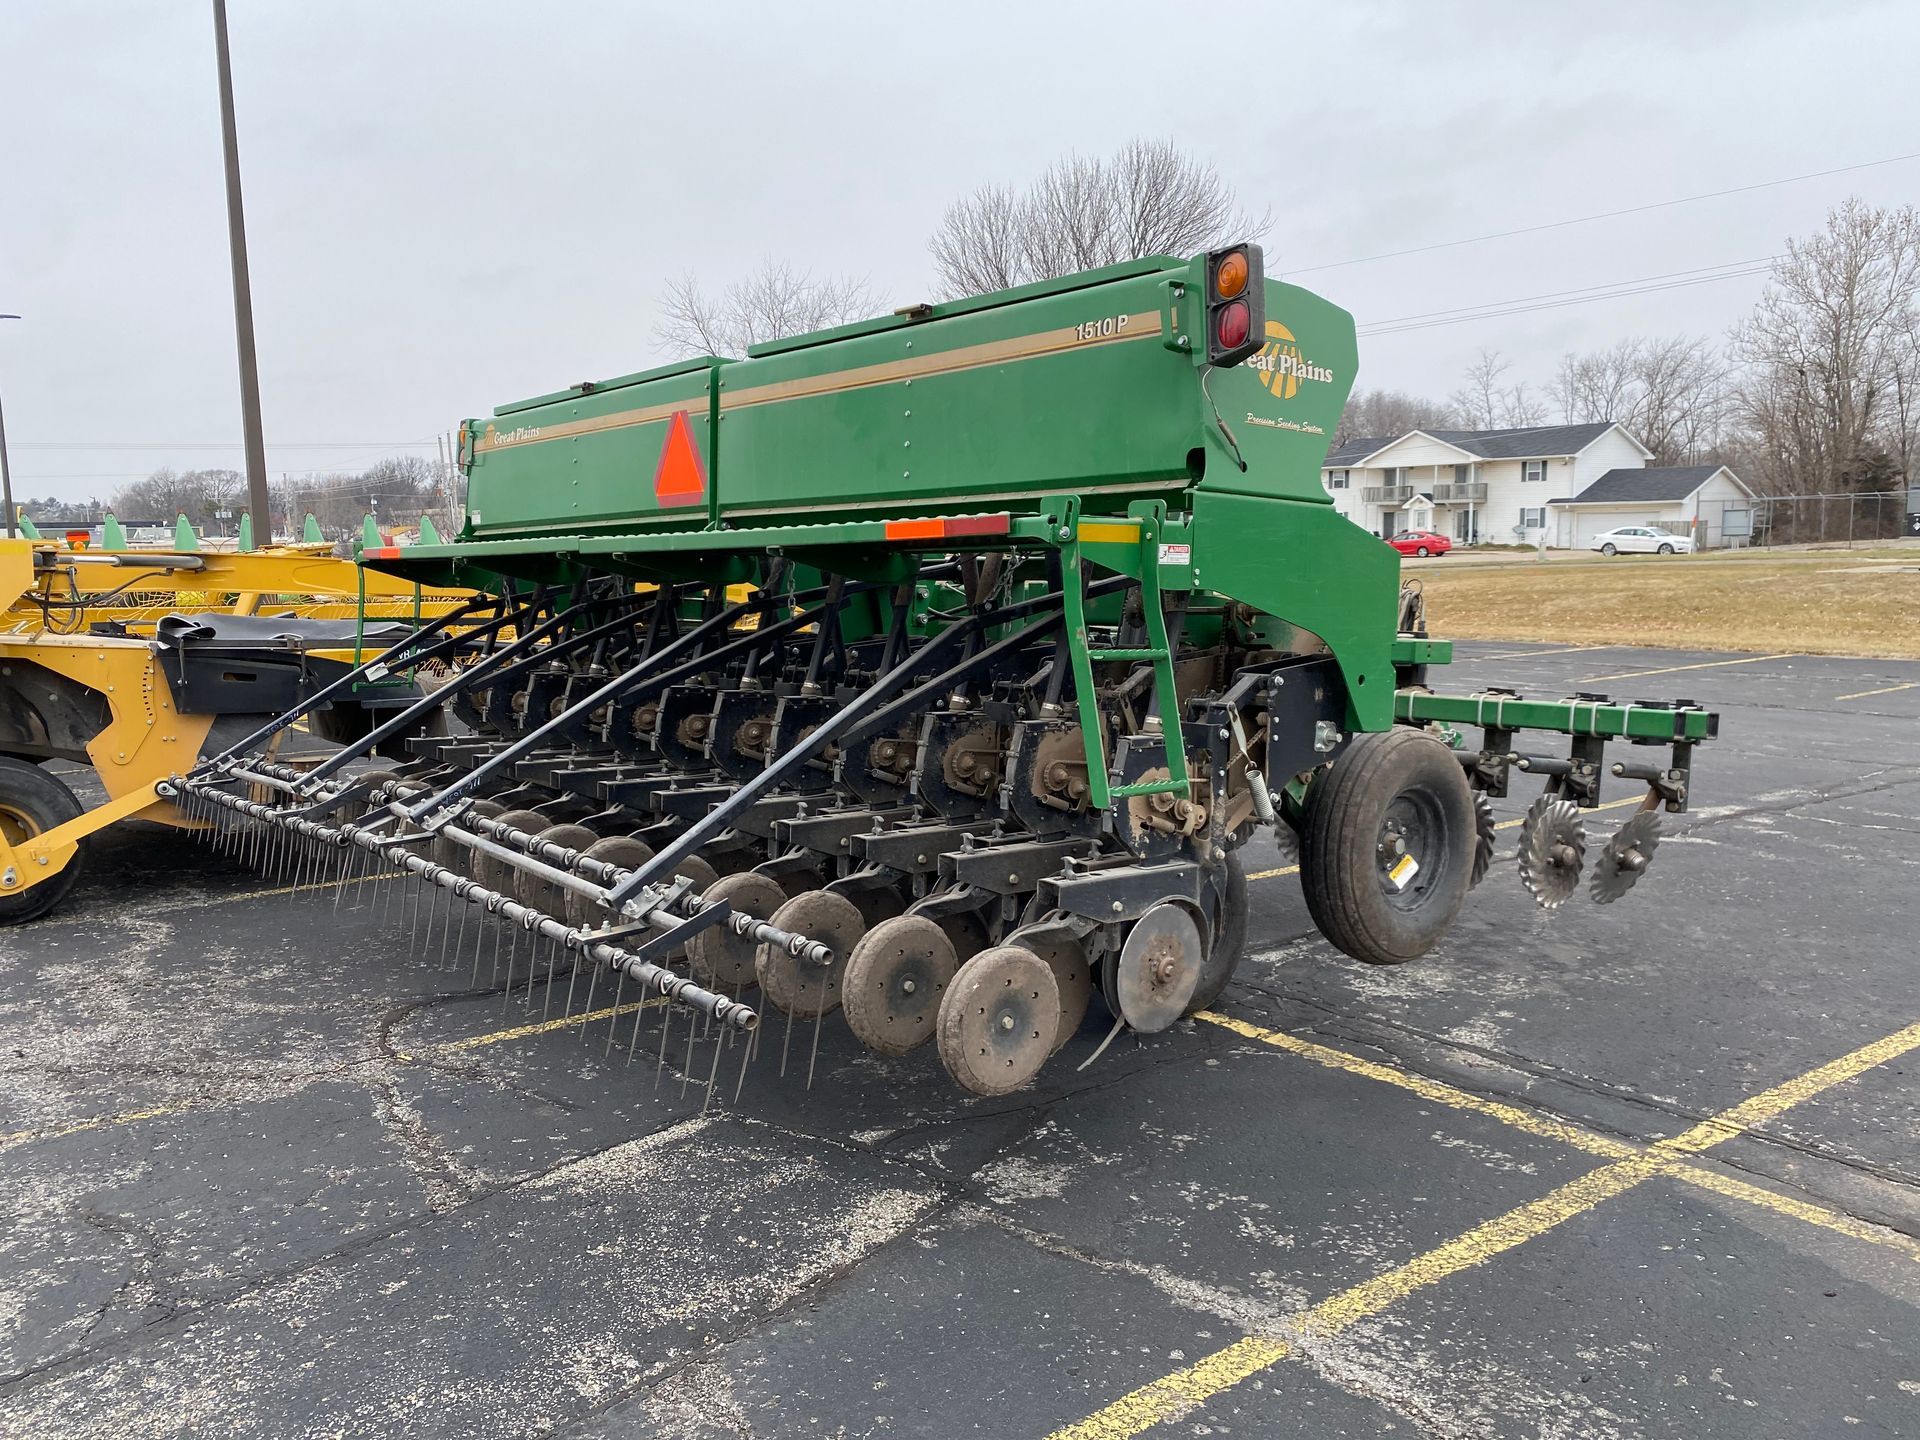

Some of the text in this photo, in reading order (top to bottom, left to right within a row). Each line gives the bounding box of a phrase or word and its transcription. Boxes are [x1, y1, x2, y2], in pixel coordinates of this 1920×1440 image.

[1075, 314, 1129, 341] 1510 P
[1238, 354, 1333, 383] eat Plains
[494, 425, 540, 445] Great Plains
[1246, 412, 1323, 434] Precision Seeding System
